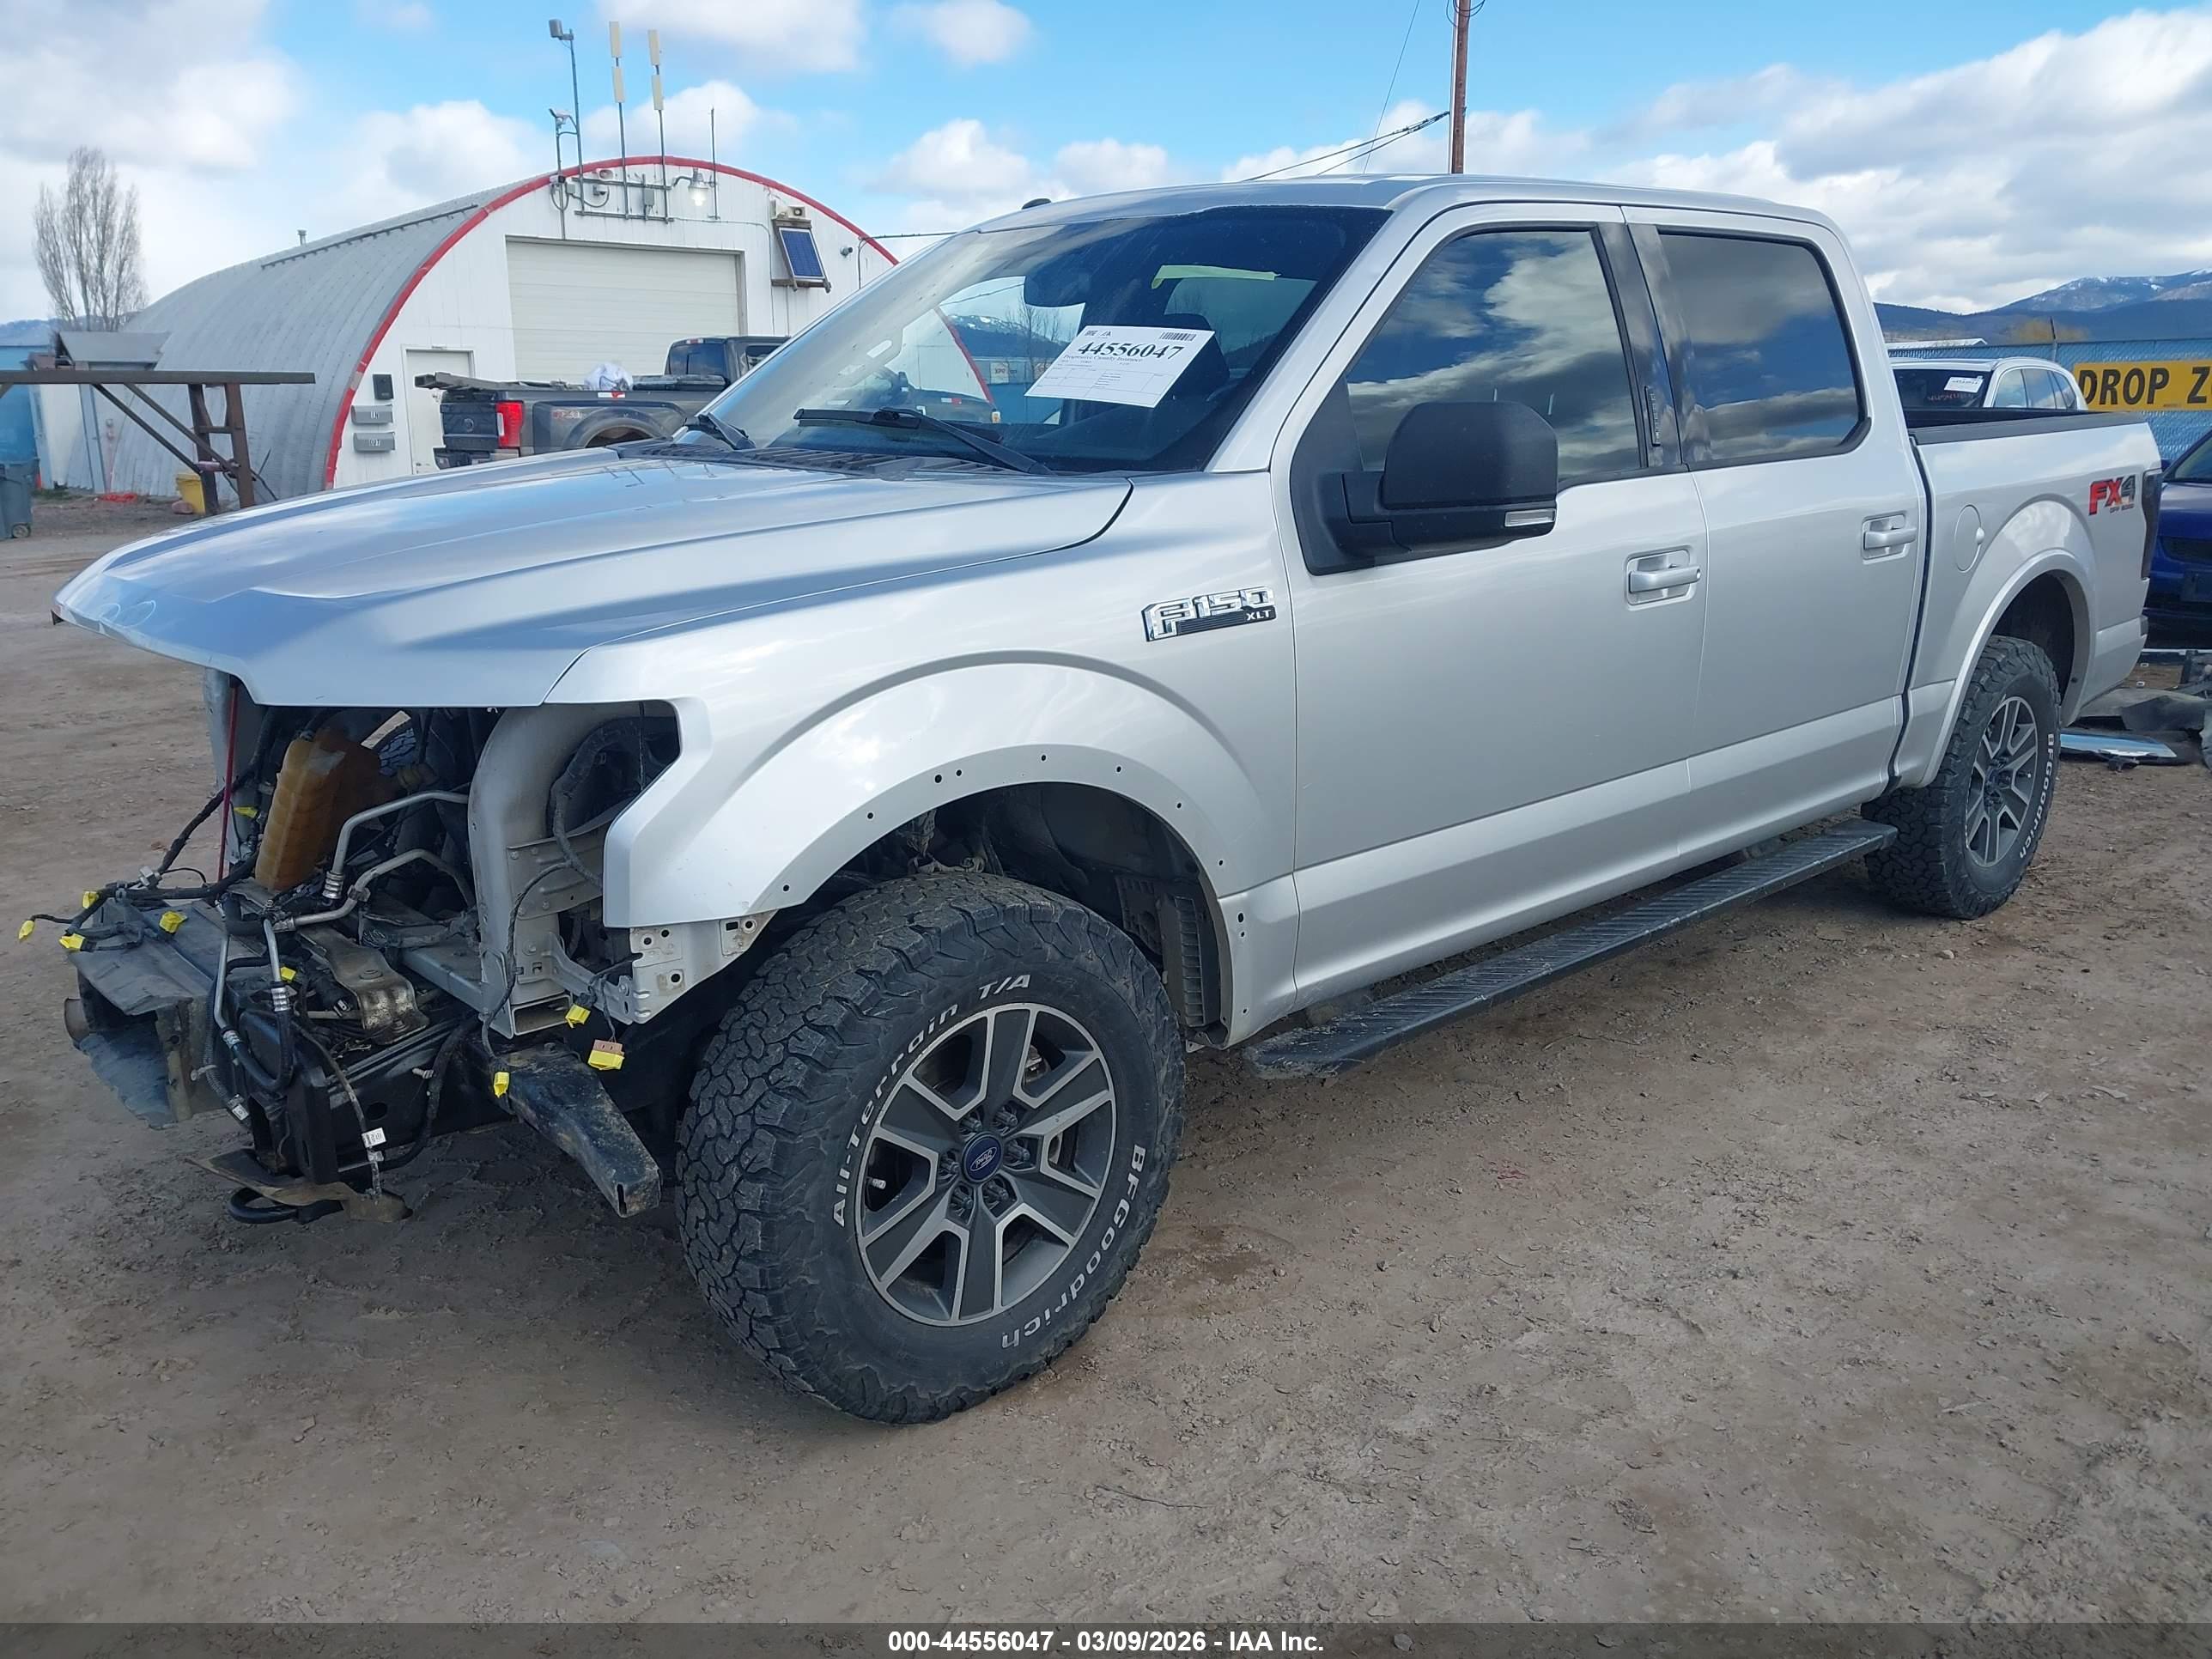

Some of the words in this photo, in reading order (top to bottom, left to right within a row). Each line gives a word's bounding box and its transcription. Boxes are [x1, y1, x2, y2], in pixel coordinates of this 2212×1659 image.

[1079, 342, 1185, 359] 44556047
[2079, 368, 2169, 404] DROP
[2187, 366, 2212, 404] Z
[2088, 475, 2136, 516] FX4
[1246, 609, 1272, 621] XLT
[979, 974, 1030, 1000] T/A
[975, 1149, 993, 1169] Ford
[1001, 1144, 1146, 1349] BFGoodrich
